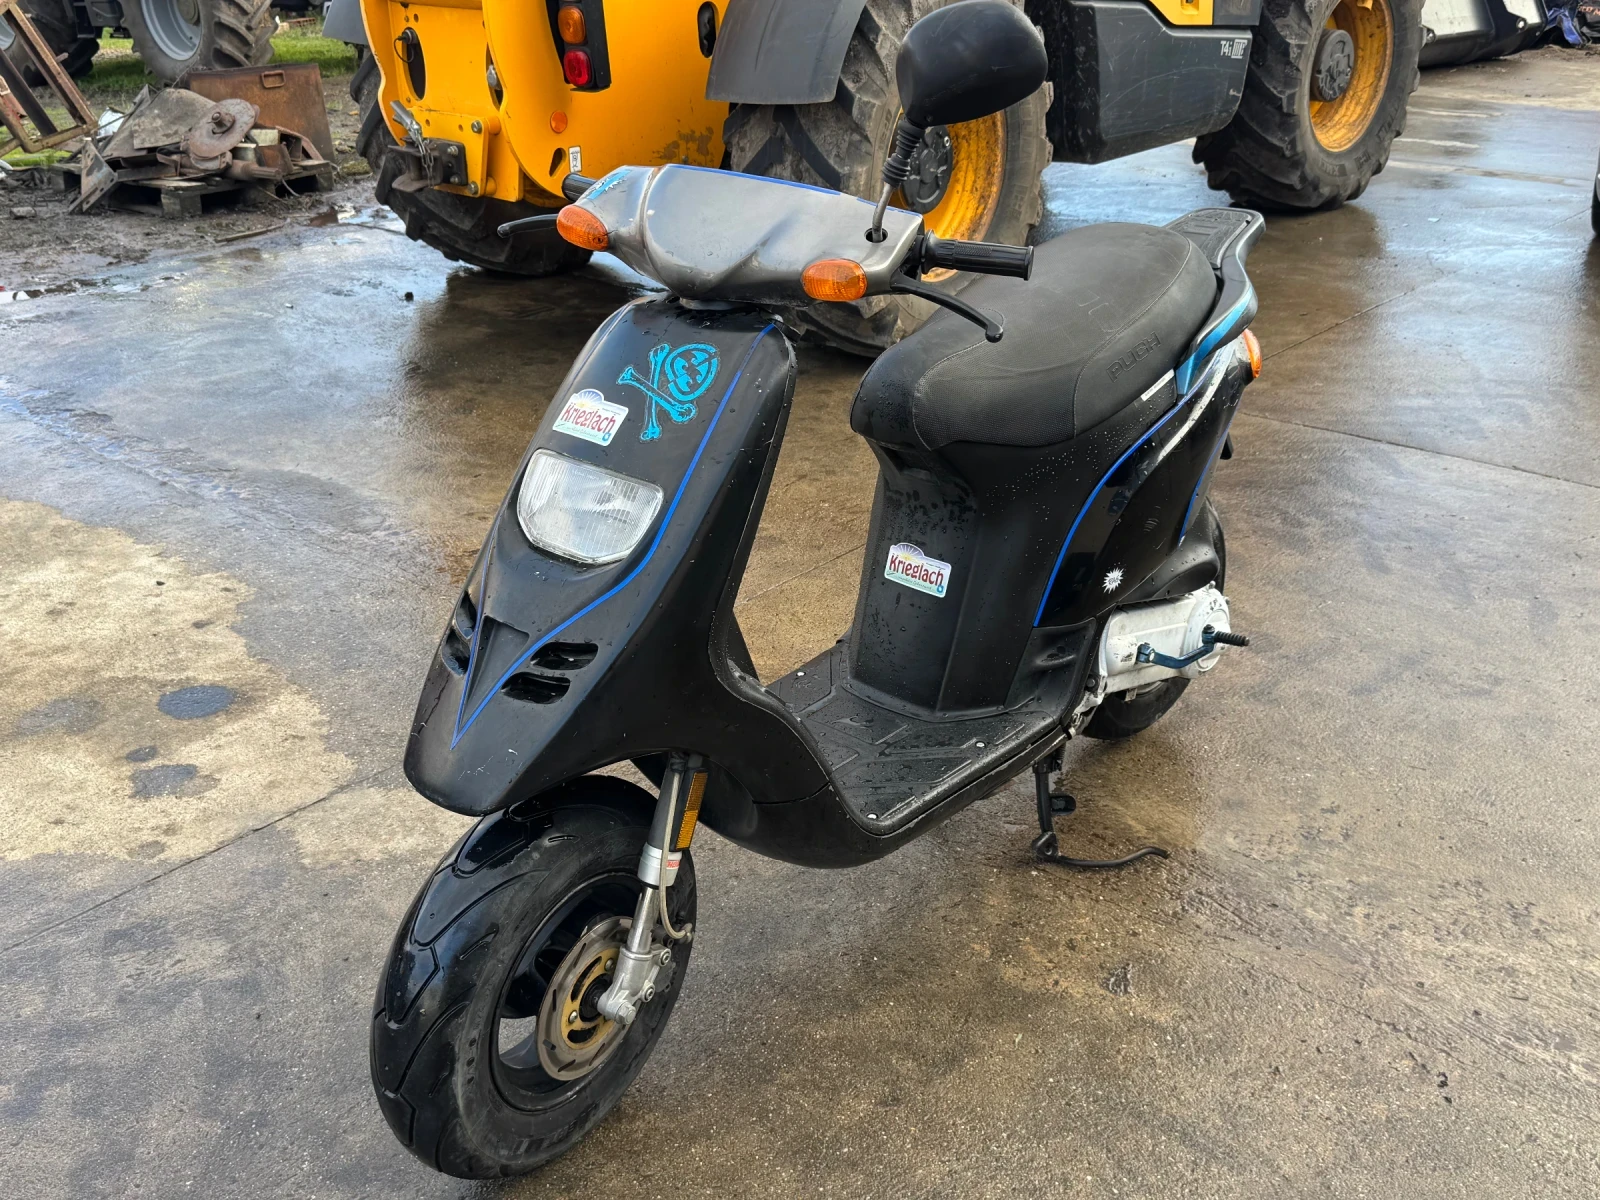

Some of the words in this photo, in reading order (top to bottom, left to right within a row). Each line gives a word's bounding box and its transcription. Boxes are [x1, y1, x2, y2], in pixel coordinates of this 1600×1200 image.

[1106, 331, 1162, 383] PUCH
[560, 402, 616, 434] Krieglach
[889, 553, 944, 587] Krieglach
